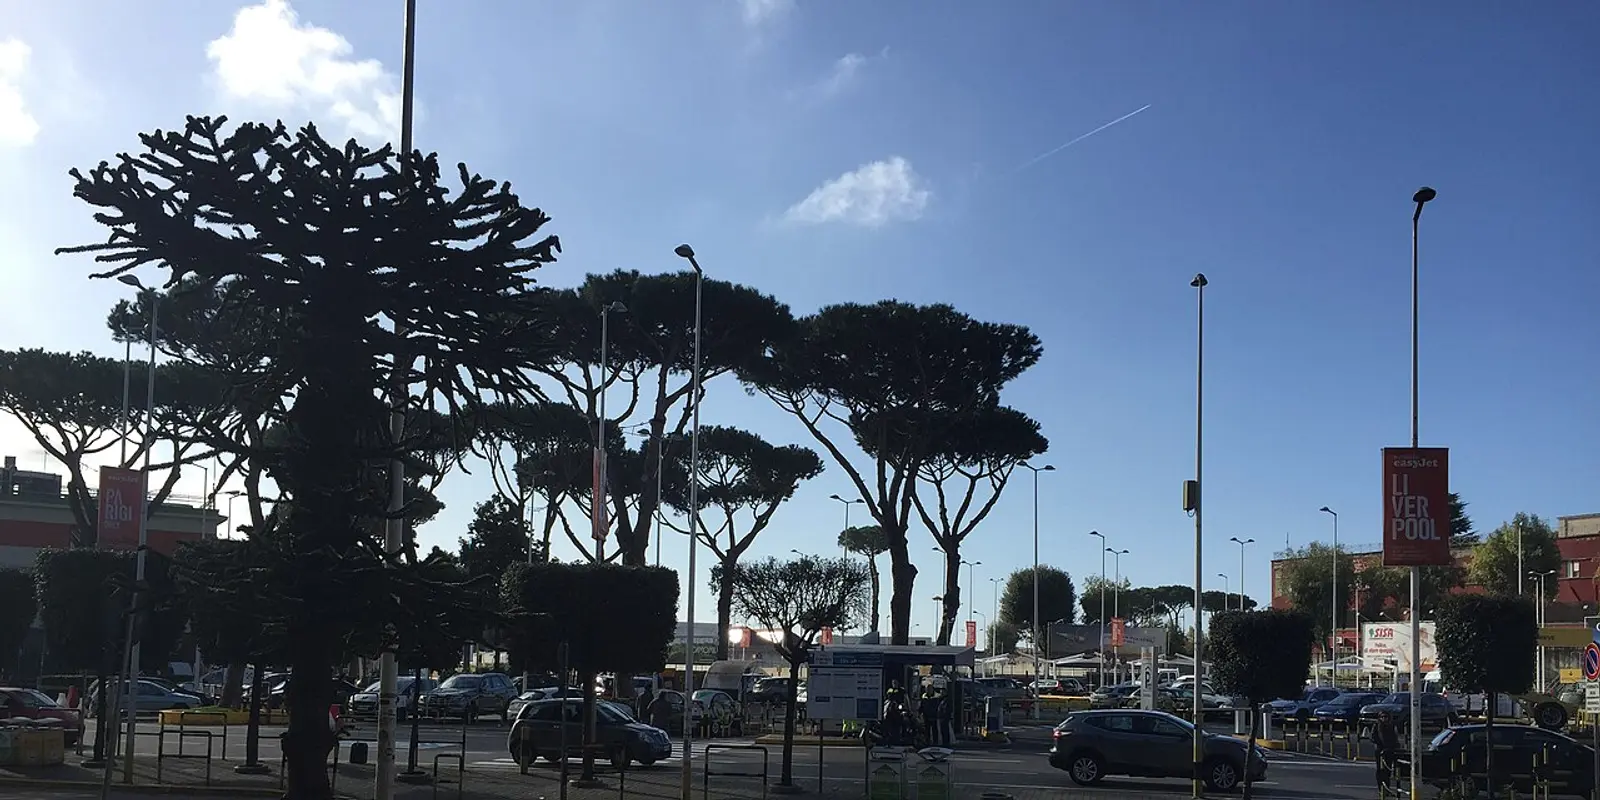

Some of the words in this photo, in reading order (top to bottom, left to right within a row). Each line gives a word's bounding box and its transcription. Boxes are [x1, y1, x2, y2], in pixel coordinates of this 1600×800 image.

[1393, 459, 1439, 469] easyJet
[1392, 474, 1409, 496] LI
[106, 488, 123, 504] PA
[105, 503, 132, 521] RIGI
[1392, 496, 1429, 518] VER
[1392, 517, 1441, 540] POOL
[1375, 628, 1394, 638] SISA
